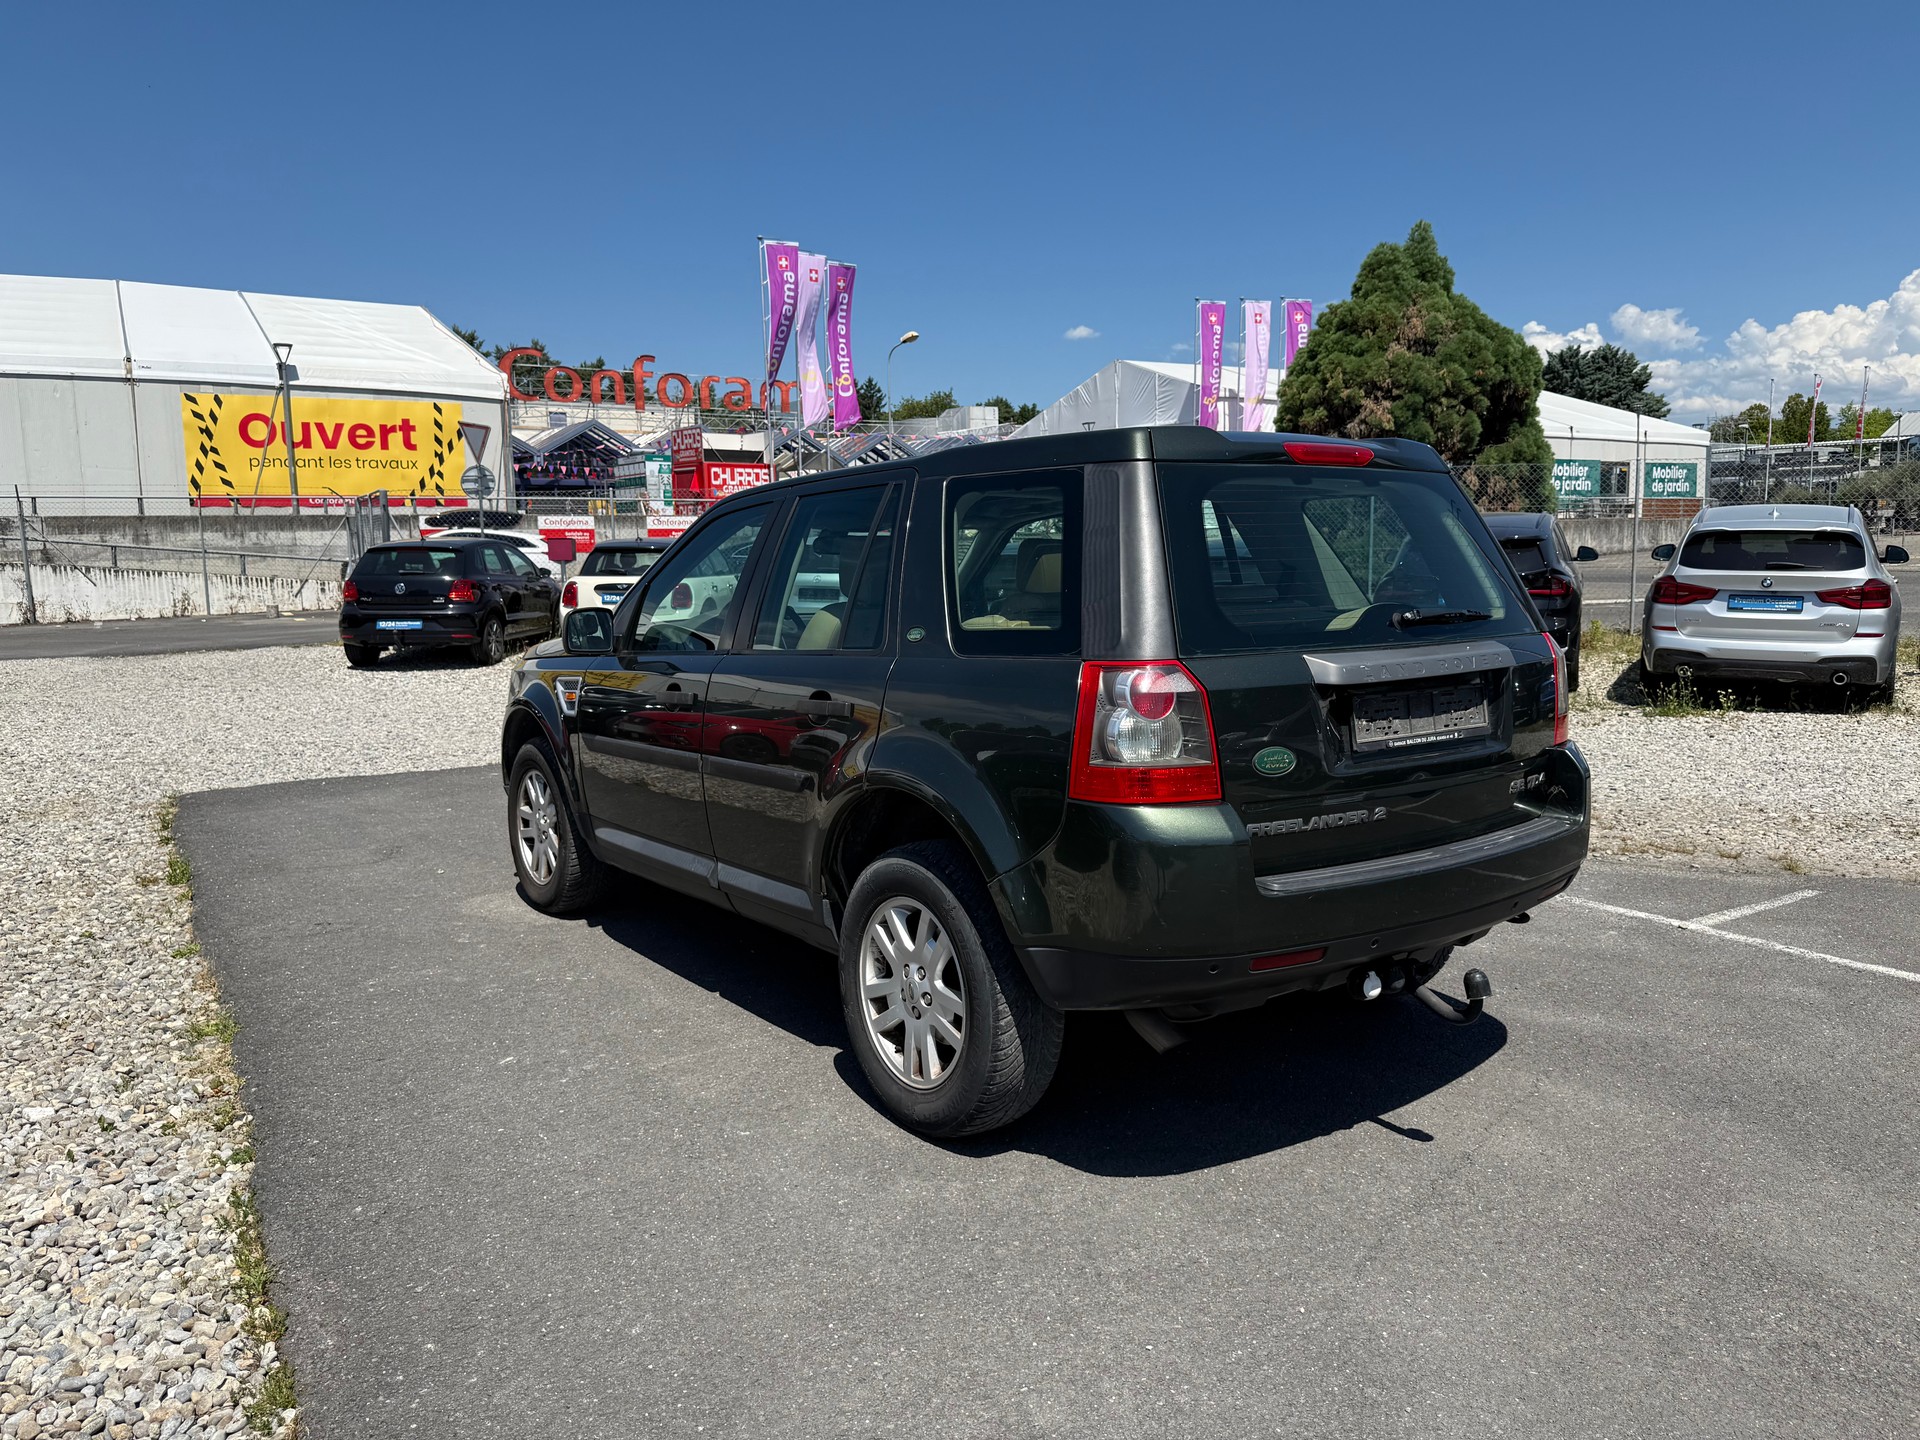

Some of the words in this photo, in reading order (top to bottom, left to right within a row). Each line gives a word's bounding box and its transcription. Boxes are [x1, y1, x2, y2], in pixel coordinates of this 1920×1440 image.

[836, 292, 854, 397] Conforama
[1204, 325, 1221, 413] Conforama
[238, 412, 417, 451] Ouvert
[673, 428, 701, 450] CHURROS
[329, 456, 352, 469] les
[355, 457, 418, 470] travaux
[1652, 465, 1687, 479] Mobilier
[710, 467, 770, 486] CHURROS
[1561, 477, 1591, 494] jardin
[1652, 479, 1663, 492] de
[1664, 479, 1689, 495] jardin
[544, 517, 588, 526] Conforama
[1362, 661, 1426, 682] LAND
[1438, 654, 1503, 672] ROVER
[1246, 810, 1369, 837] FREELANDER
[1372, 806, 1387, 821] 2
